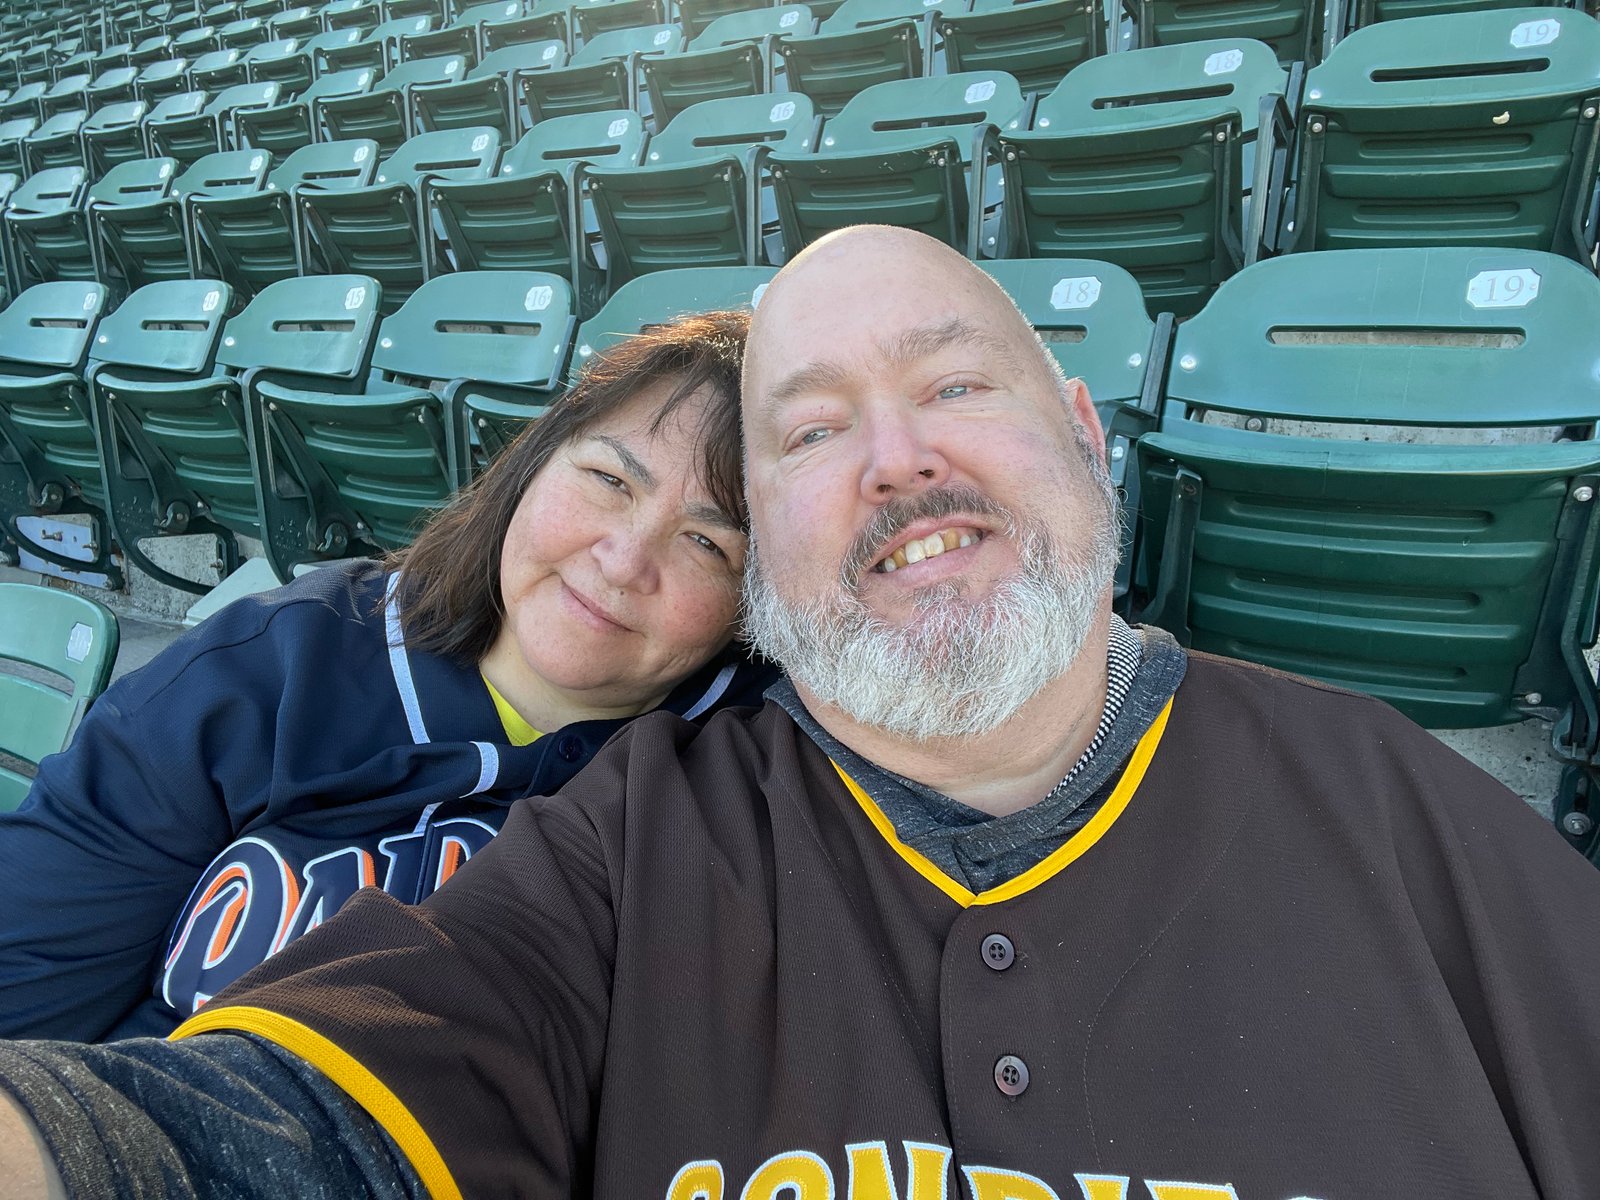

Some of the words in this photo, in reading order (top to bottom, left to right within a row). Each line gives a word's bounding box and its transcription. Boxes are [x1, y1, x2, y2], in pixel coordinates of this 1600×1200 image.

[1523, 24, 1549, 43] 19
[1214, 53, 1235, 71] 18
[973, 84, 991, 100] 17
[775, 104, 790, 119] 16
[612, 121, 625, 135] 15
[349, 289, 363, 306] 15
[1062, 281, 1090, 304] 18
[1487, 275, 1524, 302] 19
[532, 289, 548, 307] 16
